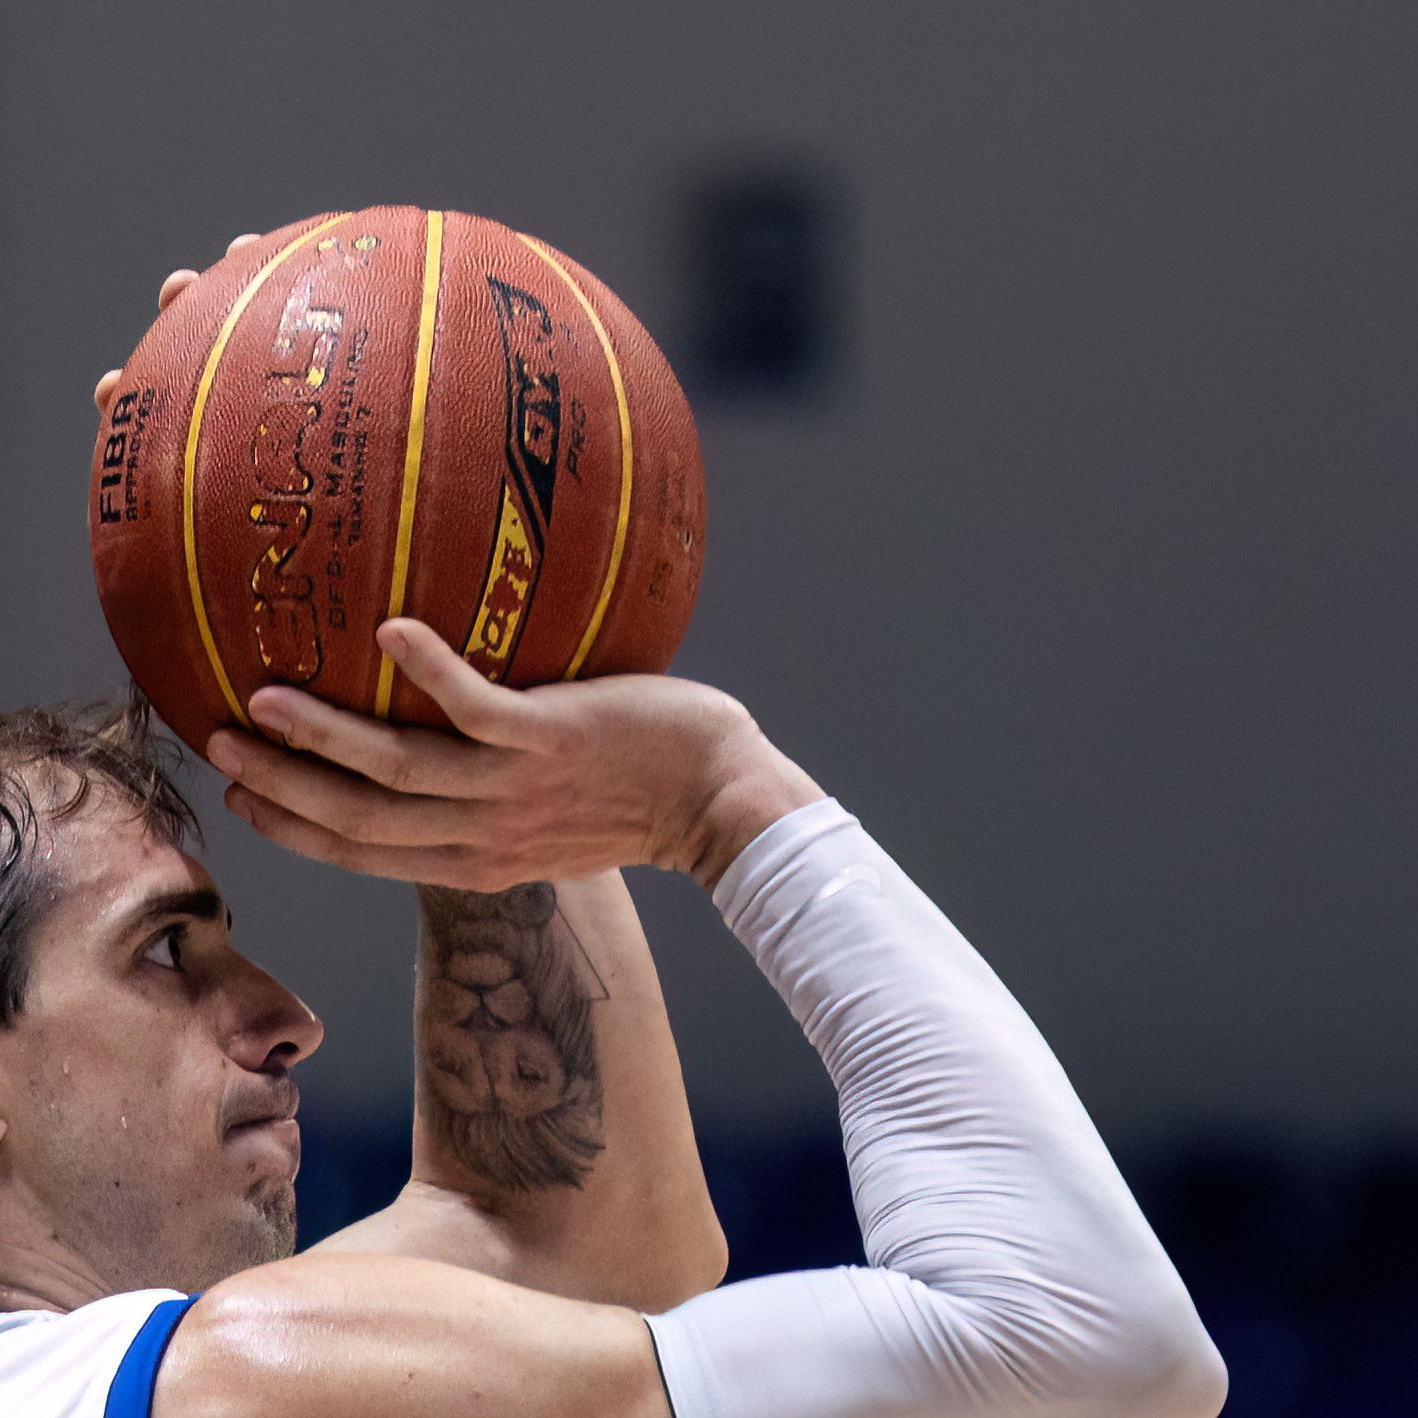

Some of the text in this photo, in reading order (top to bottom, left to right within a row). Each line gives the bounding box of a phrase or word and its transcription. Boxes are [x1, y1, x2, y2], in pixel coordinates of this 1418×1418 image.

[356, 404, 372, 425] 7
[566, 398, 587, 475] PRO
[99, 390, 139, 524] FIBA
